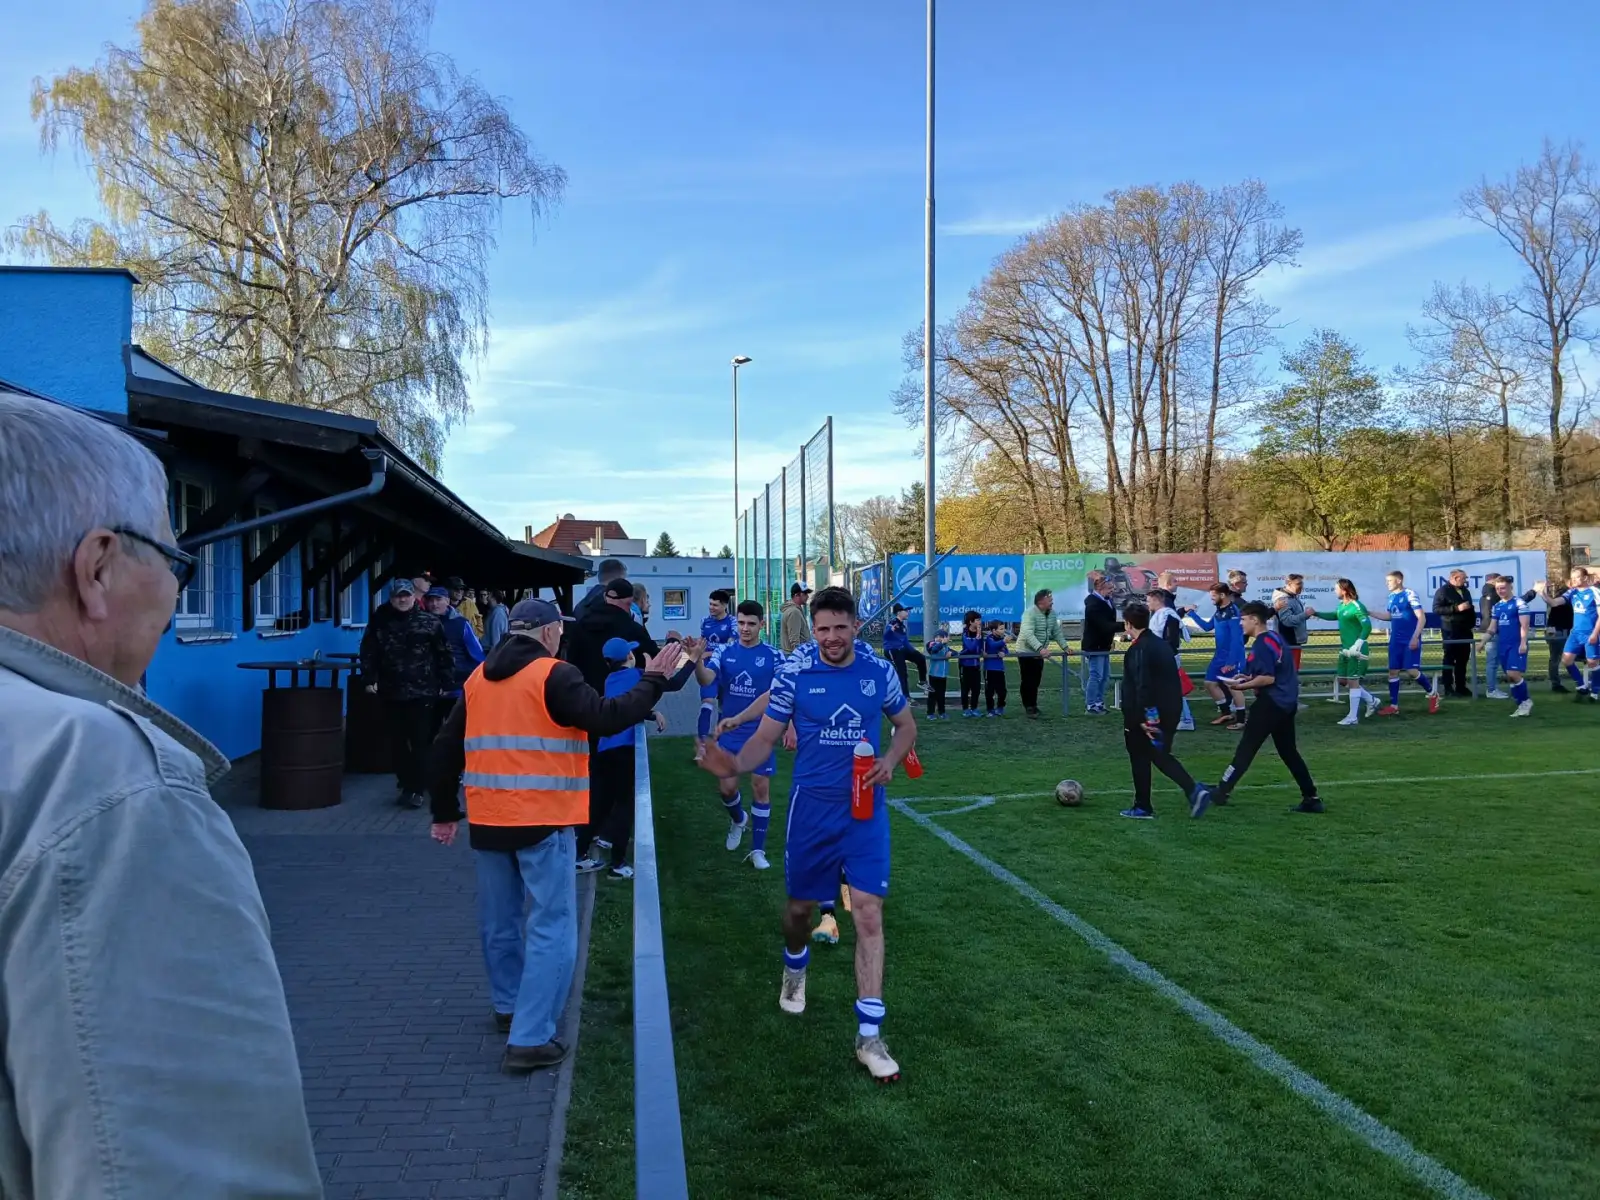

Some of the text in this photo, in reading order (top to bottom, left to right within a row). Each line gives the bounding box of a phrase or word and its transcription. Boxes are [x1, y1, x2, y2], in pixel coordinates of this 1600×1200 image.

[1032, 559, 1085, 571] AGRICO
[939, 566, 1018, 592] JAKO
[729, 683, 757, 694] Rektor
[819, 727, 867, 740] Rektor
